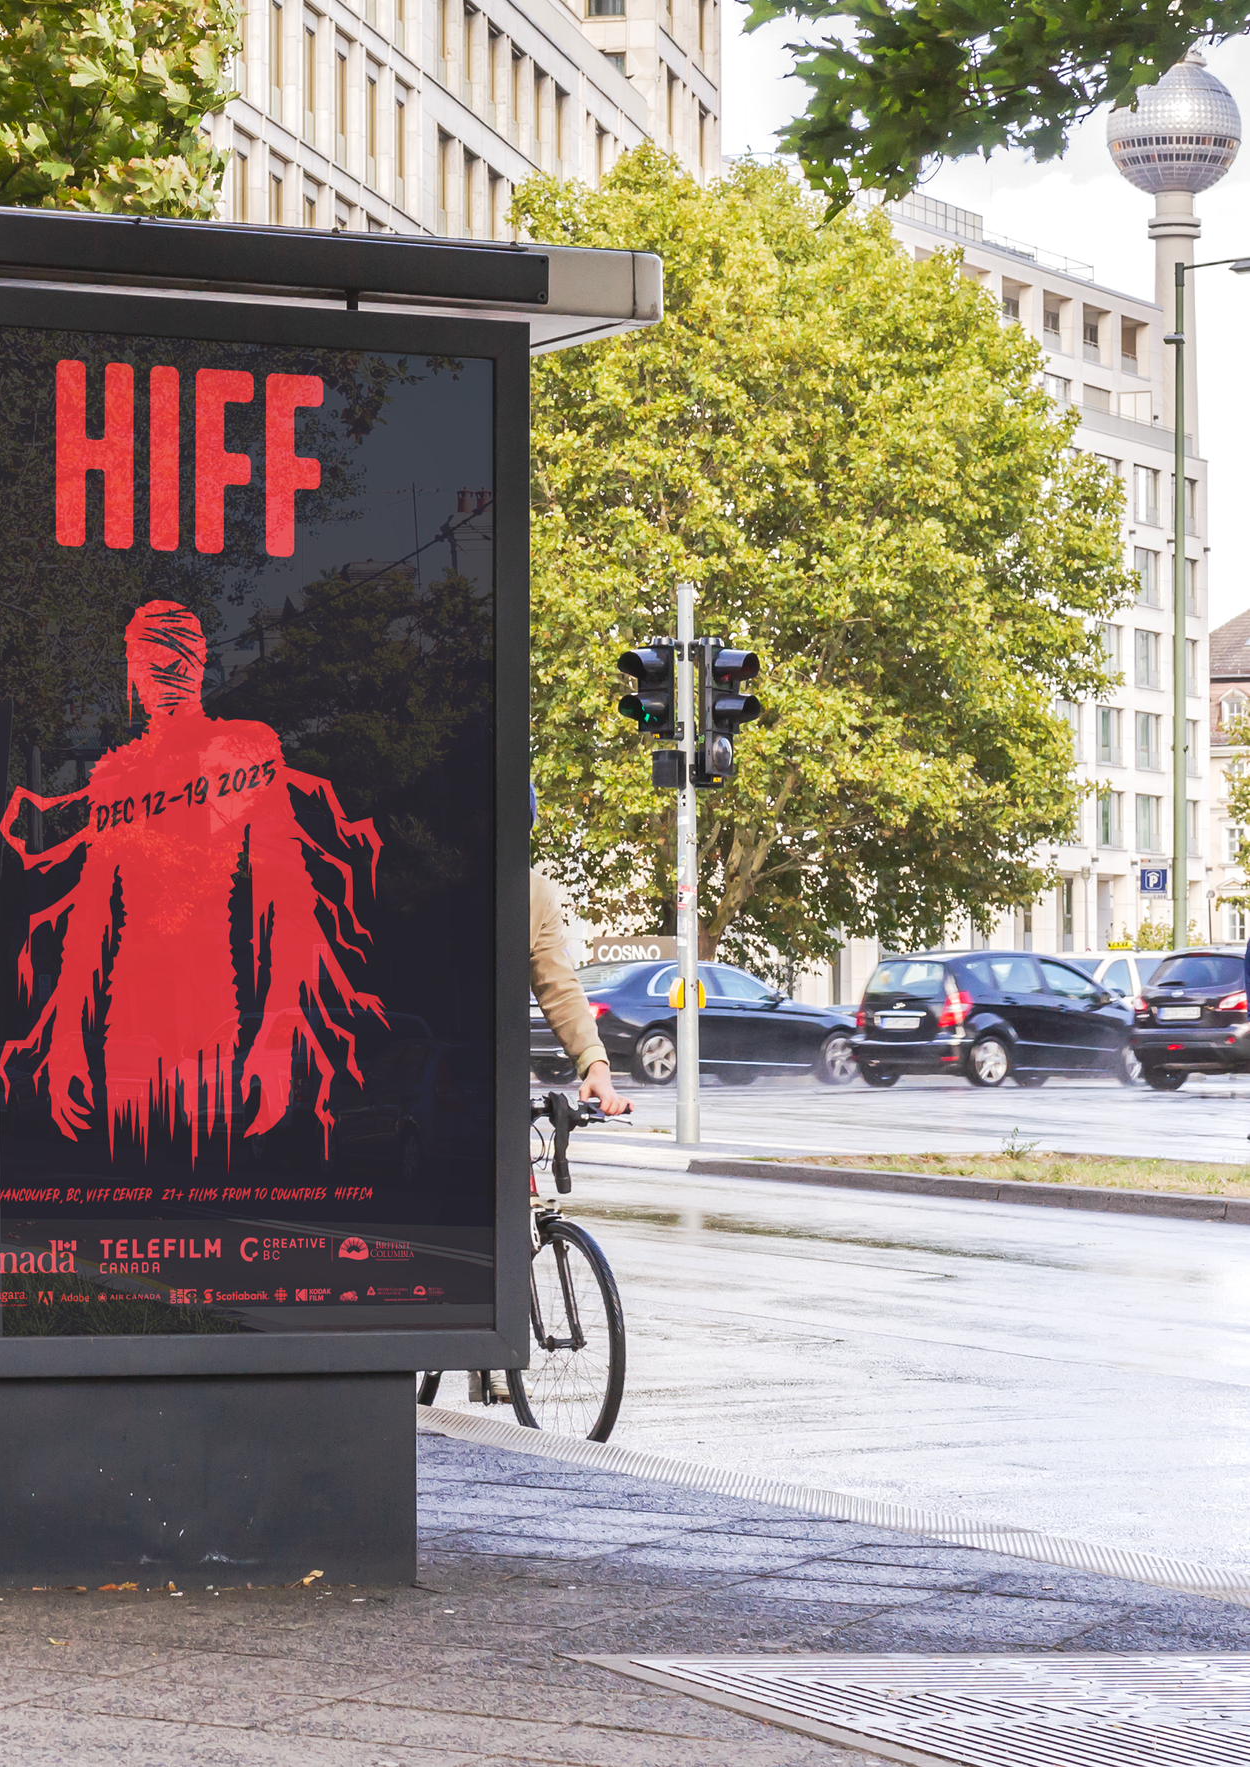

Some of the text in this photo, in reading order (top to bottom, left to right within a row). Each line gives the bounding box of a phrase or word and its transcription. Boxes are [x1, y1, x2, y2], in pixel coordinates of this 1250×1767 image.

[55, 359, 324, 557] HIFF
[96, 796, 135, 833] DEC
[217, 759, 276, 798] 2025
[597, 944, 661, 962] COSMO
[66, 1187, 84, 1204] BC,
[86, 1188, 111, 1203] VIFF
[113, 1187, 153, 1202] CENTER
[161, 1187, 185, 1201] 21+
[188, 1187, 219, 1202] FILMS
[222, 1187, 251, 1202] FROM
[254, 1187, 268, 1200] 10
[270, 1187, 327, 1202] COUNTRIES
[334, 1186, 374, 1202] HIFF.CA
[100, 1238, 222, 1259] TELEFILM
[263, 1238, 326, 1249] CREATIVE
[263, 1250, 281, 1261] BC
[100, 1262, 160, 1274] CANADA
[60, 1293, 90, 1302] Adobe
